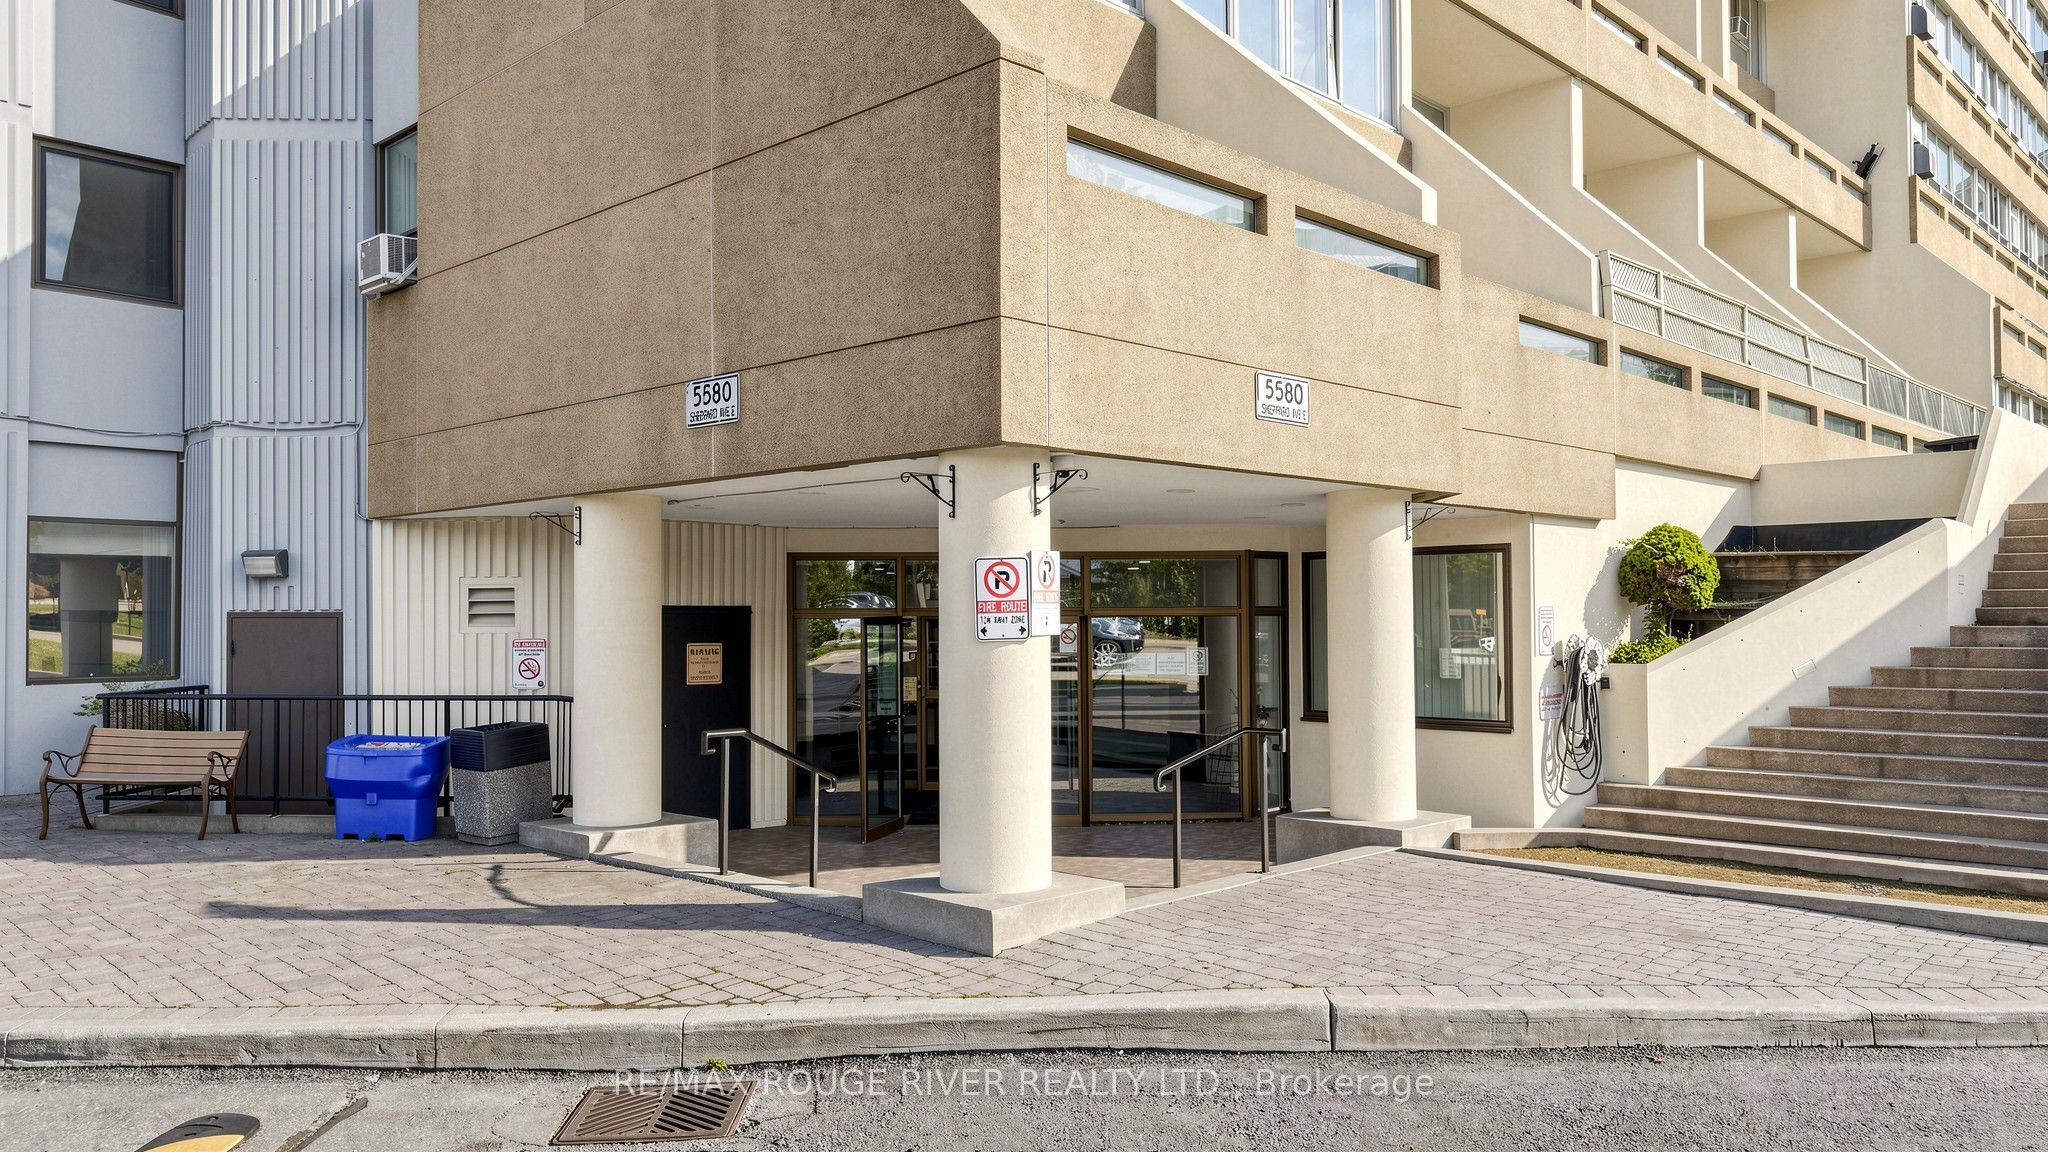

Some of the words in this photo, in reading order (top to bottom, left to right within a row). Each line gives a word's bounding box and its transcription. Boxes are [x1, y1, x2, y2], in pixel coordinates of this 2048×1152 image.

[693, 380, 732, 407] 5580
[1265, 378, 1303, 405] 5580
[977, 602, 997, 613] FIRE
[1000, 600, 1027, 612] ROUTE
[993, 615, 1008, 624] AWAY
[1010, 615, 1025, 624] ZONE
